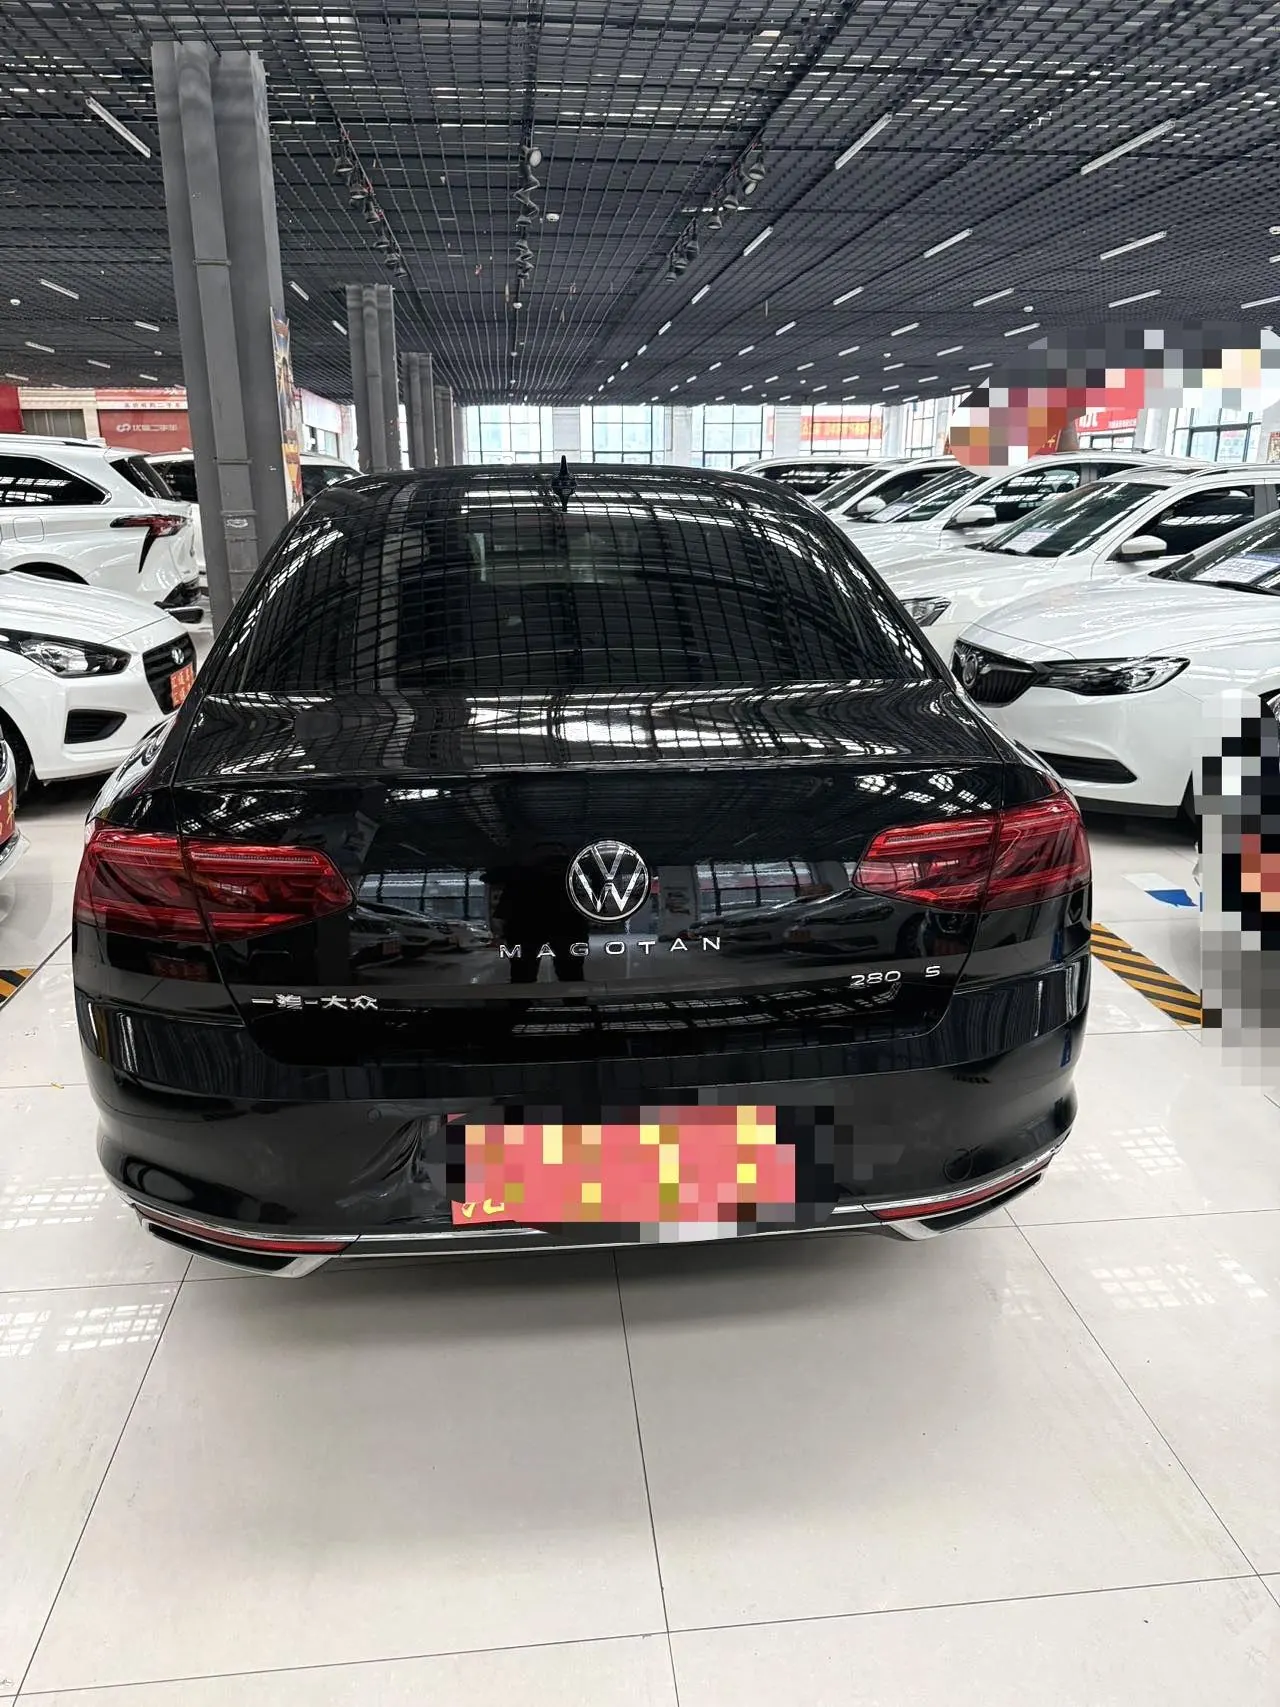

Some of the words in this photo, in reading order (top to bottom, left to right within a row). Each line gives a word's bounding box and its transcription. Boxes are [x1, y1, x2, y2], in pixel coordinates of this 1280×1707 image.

[498, 936, 721, 959] MAGOTAN
[850, 970, 902, 986] 280
[925, 965, 941, 978] S
